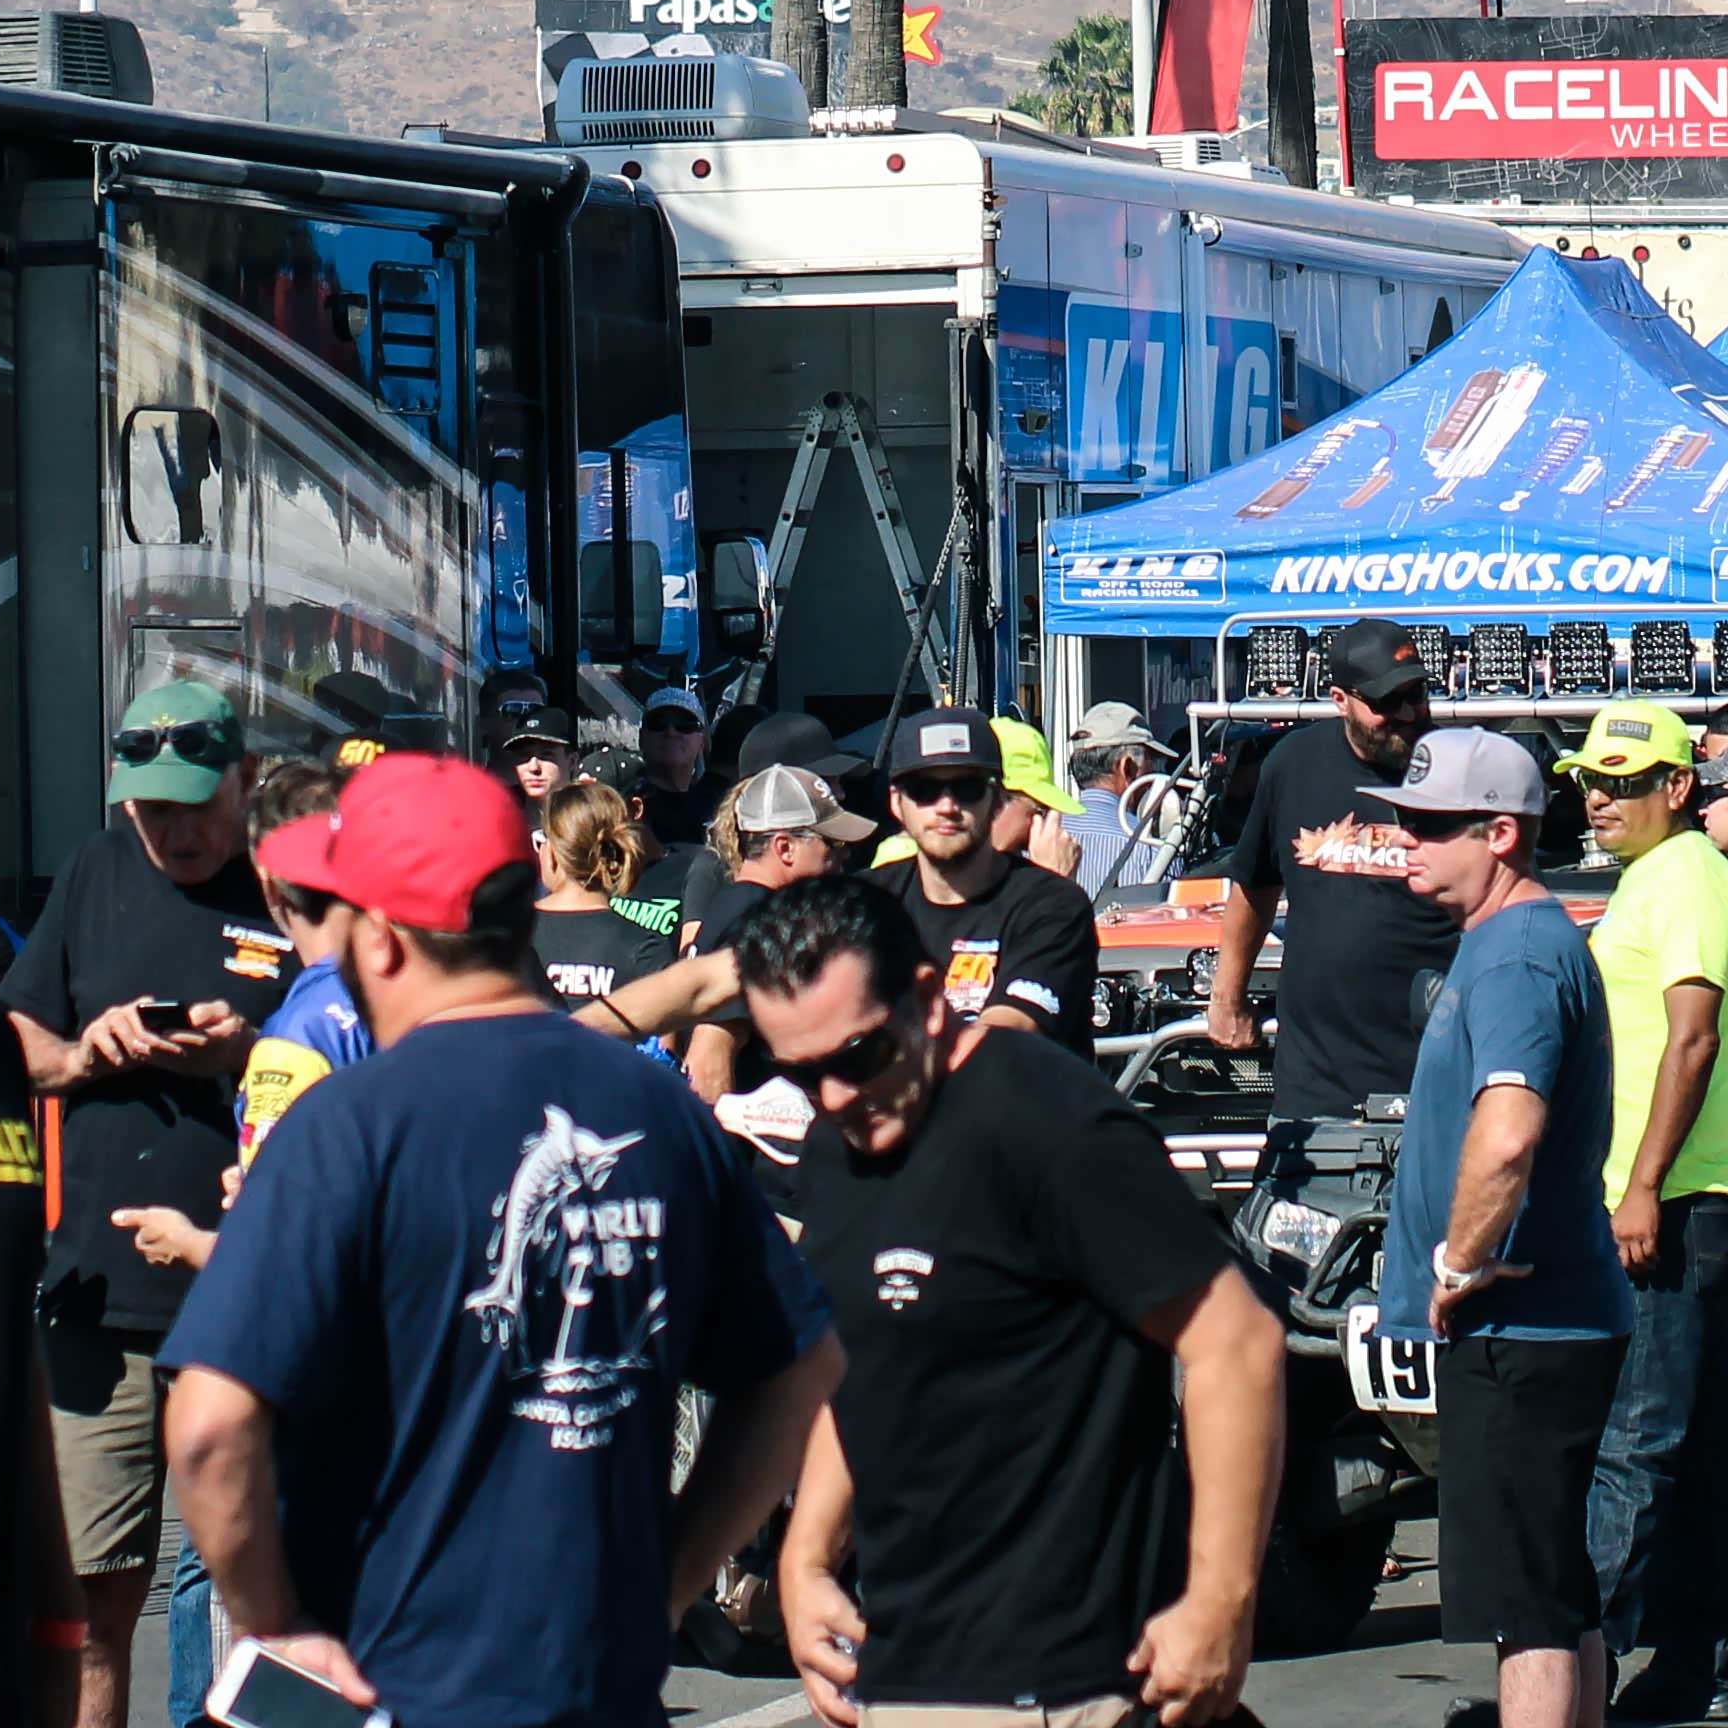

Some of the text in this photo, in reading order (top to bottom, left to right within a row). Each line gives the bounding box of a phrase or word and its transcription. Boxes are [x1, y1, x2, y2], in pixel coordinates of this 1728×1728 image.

[1081, 338, 1272, 476] KING
[1066, 555, 1220, 577] KING
[1272, 551, 1670, 596] KINGSHOCKS.COM
[1080, 588, 1200, 598] RACING SHOCKS
[1140, 581, 1185, 589] ROAD
[1609, 721, 1650, 735] SCORE
[546, 963, 615, 996] CREW
